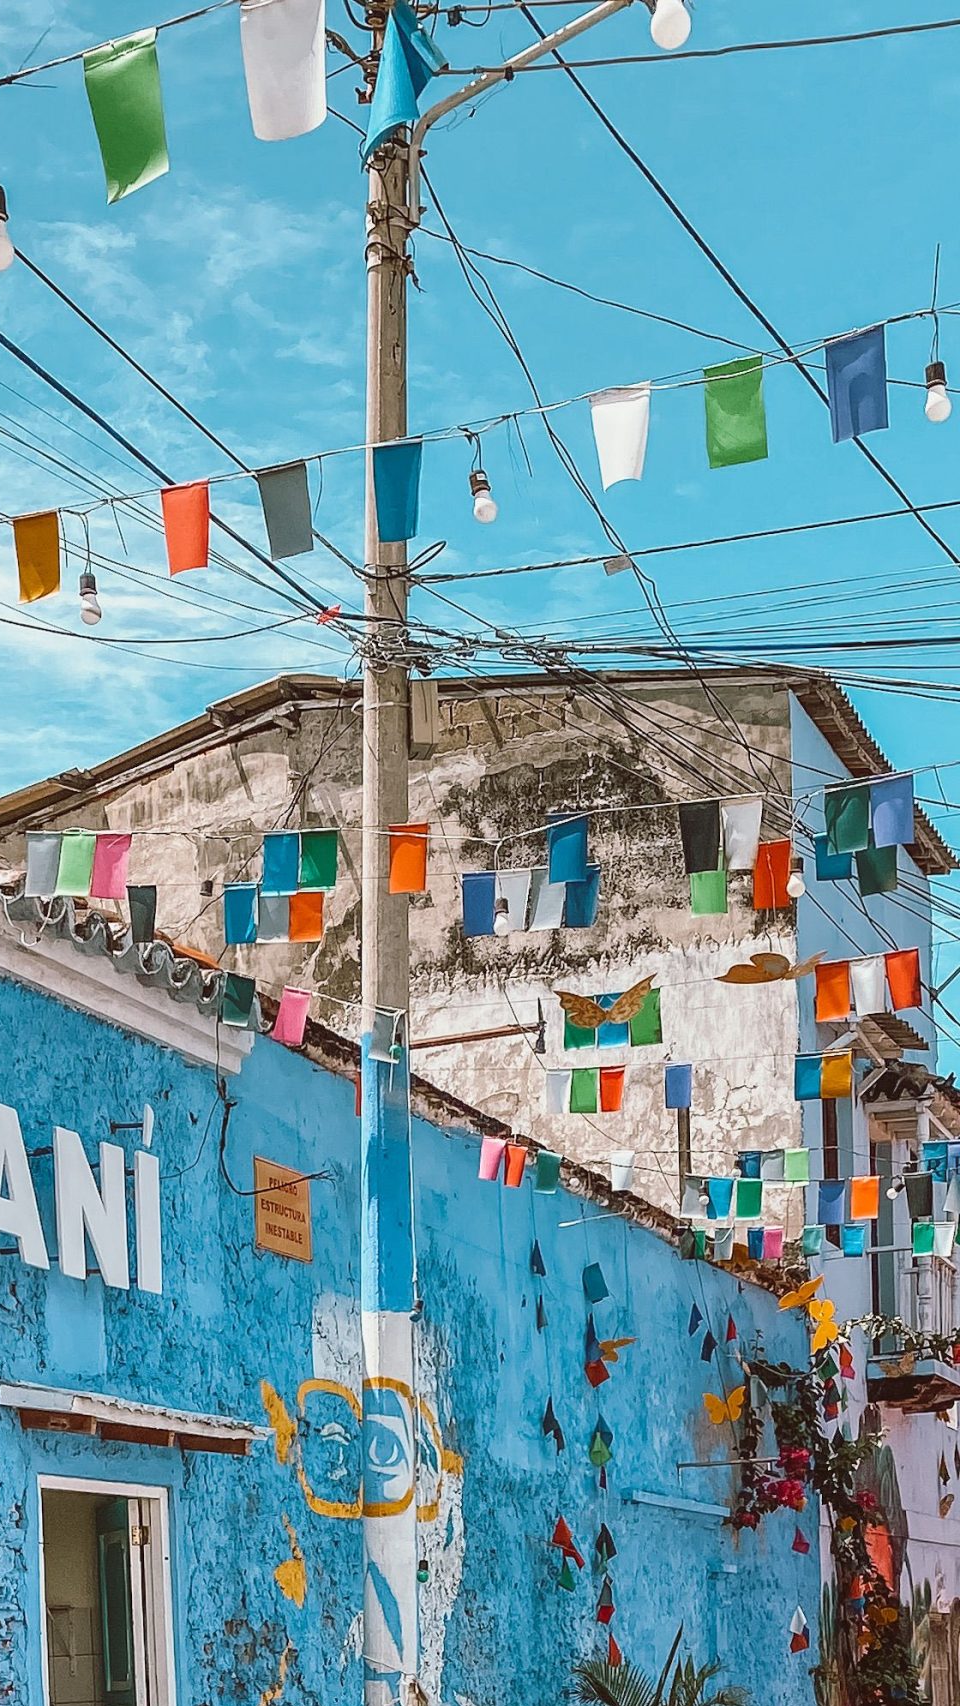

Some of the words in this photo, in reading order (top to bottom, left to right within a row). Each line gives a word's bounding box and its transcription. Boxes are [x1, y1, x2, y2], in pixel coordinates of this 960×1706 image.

[268, 1177, 298, 1196] PELIGRO
[260, 1198, 306, 1225] ESTRUCTURA
[264, 1222, 303, 1245] INESTABLE
